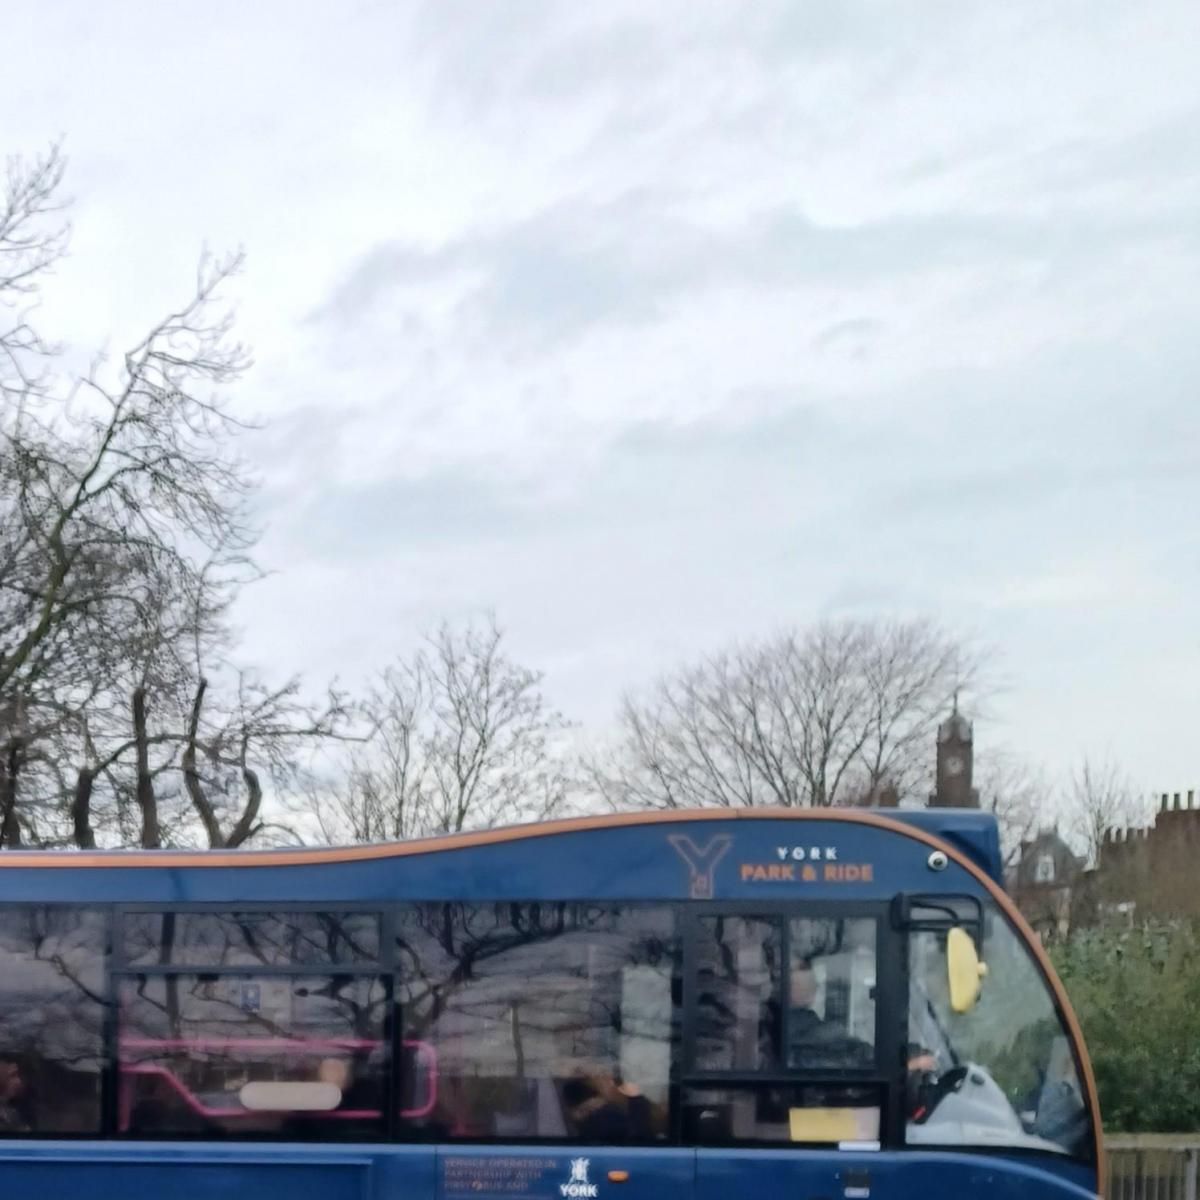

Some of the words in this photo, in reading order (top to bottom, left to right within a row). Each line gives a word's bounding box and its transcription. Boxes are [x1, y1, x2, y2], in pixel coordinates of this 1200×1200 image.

[777, 847, 838, 860] YORK
[741, 864, 794, 882] PARK
[802, 865, 817, 882] &
[824, 865, 874, 882] RIDE
[560, 1184, 598, 1198] YORK
